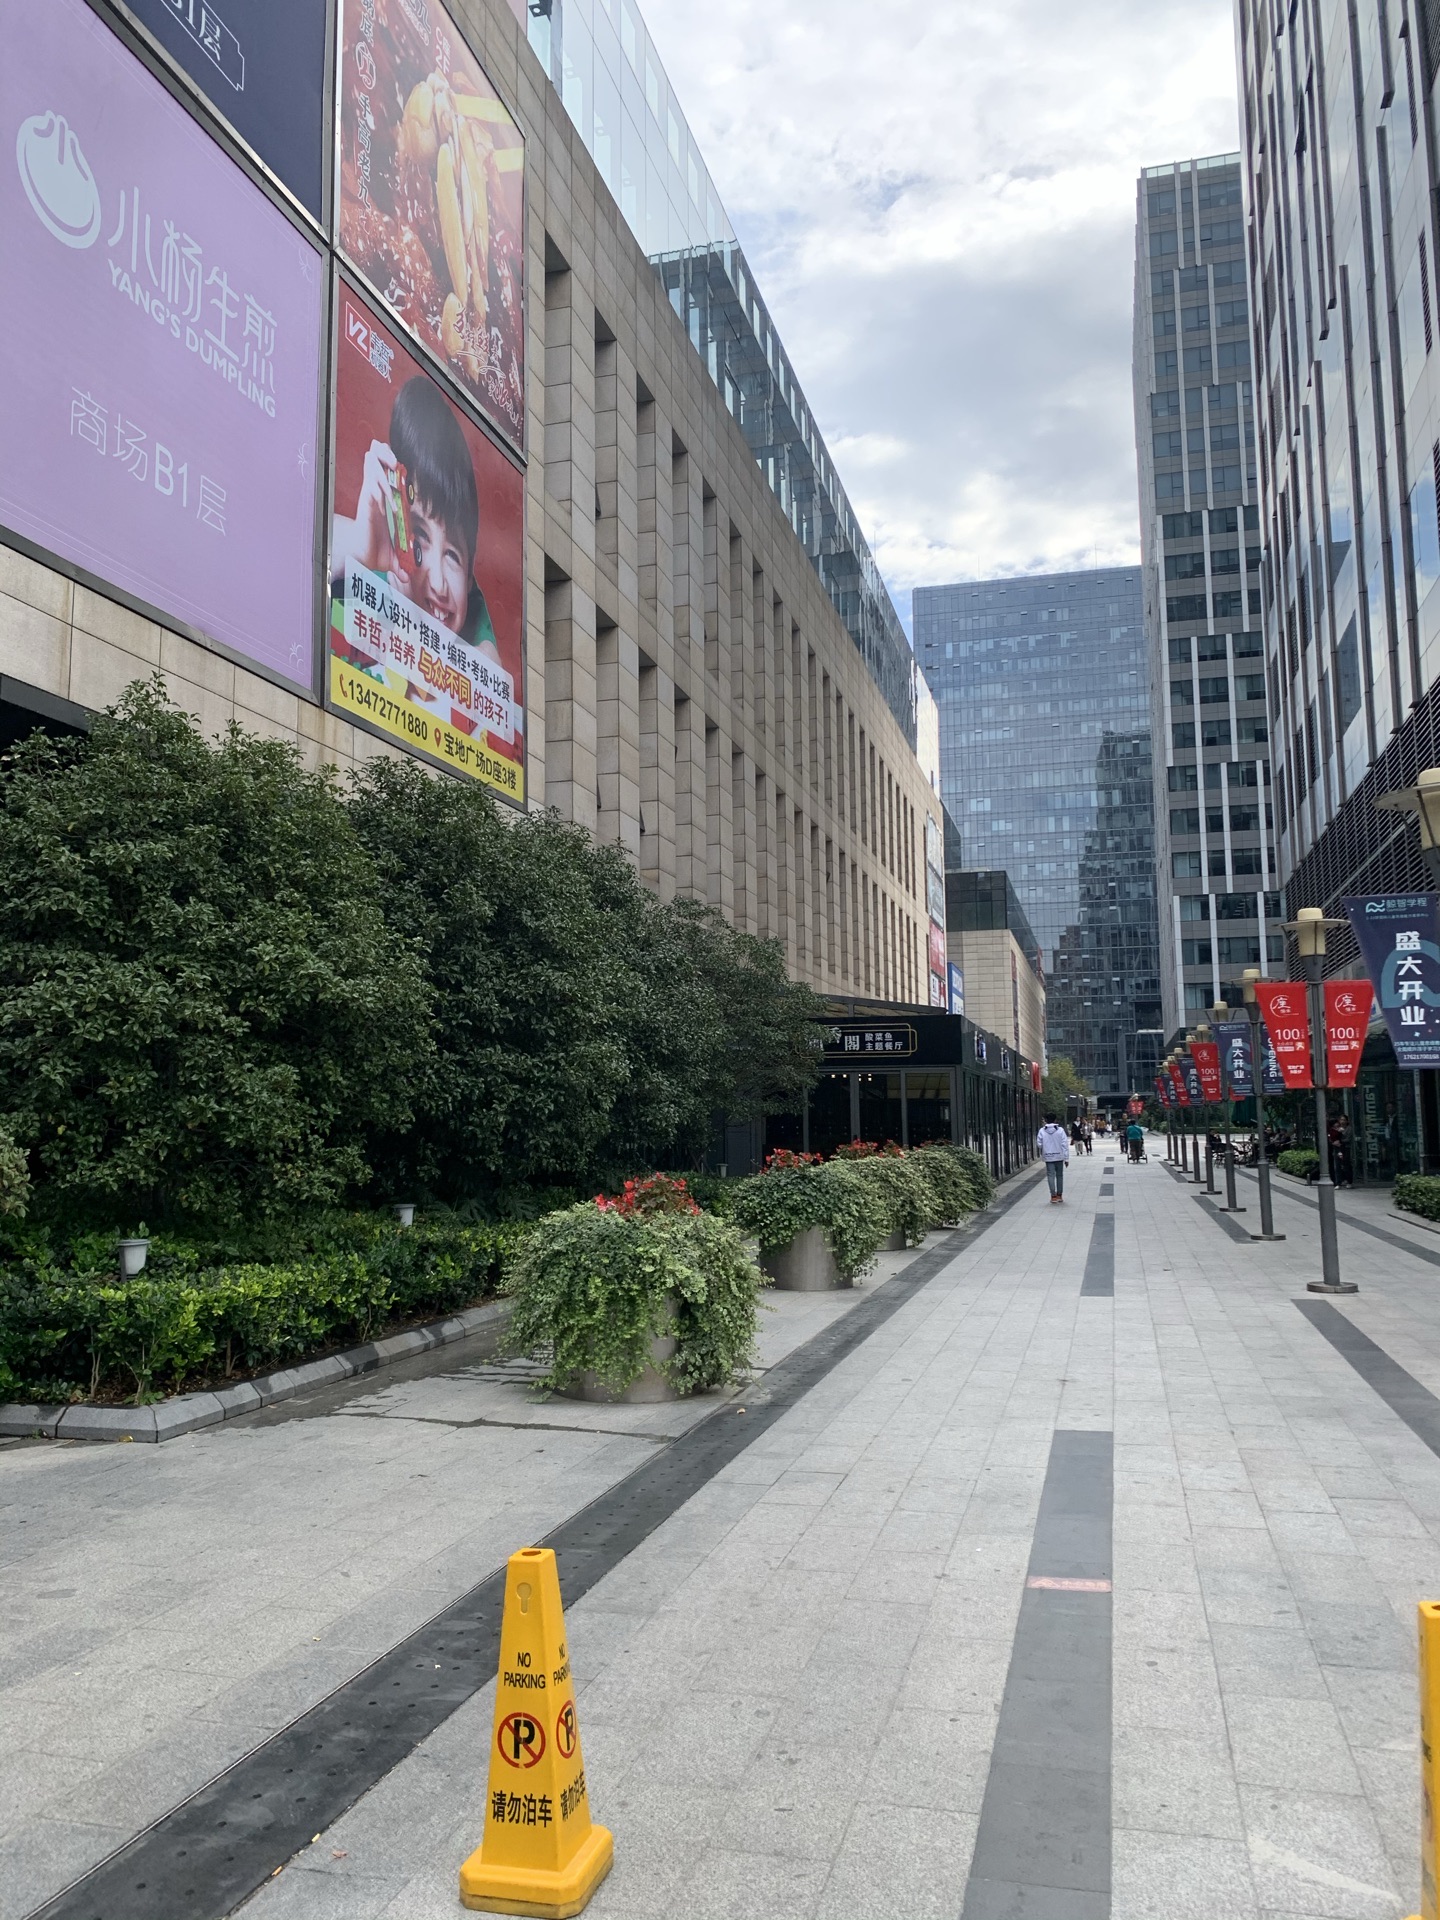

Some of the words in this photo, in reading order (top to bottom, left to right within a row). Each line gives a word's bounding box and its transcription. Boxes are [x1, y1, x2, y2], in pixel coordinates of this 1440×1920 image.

[107, 186, 277, 394] 小杨生煎
[107, 258, 181, 339] YANG'S
[185, 325, 276, 418] DUMPLING
[70, 386, 227, 537] 商场B1层
[348, 679, 428, 741] 13472771880
[443, 731, 517, 791] 宝地广场D座3楼
[1395, 931, 1427, 1025] 盛大开业
[864, 1032, 894, 1042] 酸菜鱼
[865, 1041, 904, 1051] 主题餐厅
[1275, 1028, 1300, 1040] 100
[1330, 1027, 1355, 1039] 100
[1231, 1038, 1245, 1079] 盛大开业
[517, 1652, 532, 1668] NO
[503, 1671, 547, 1689] PARKING
[492, 1790, 553, 1828] 请勿泊车
